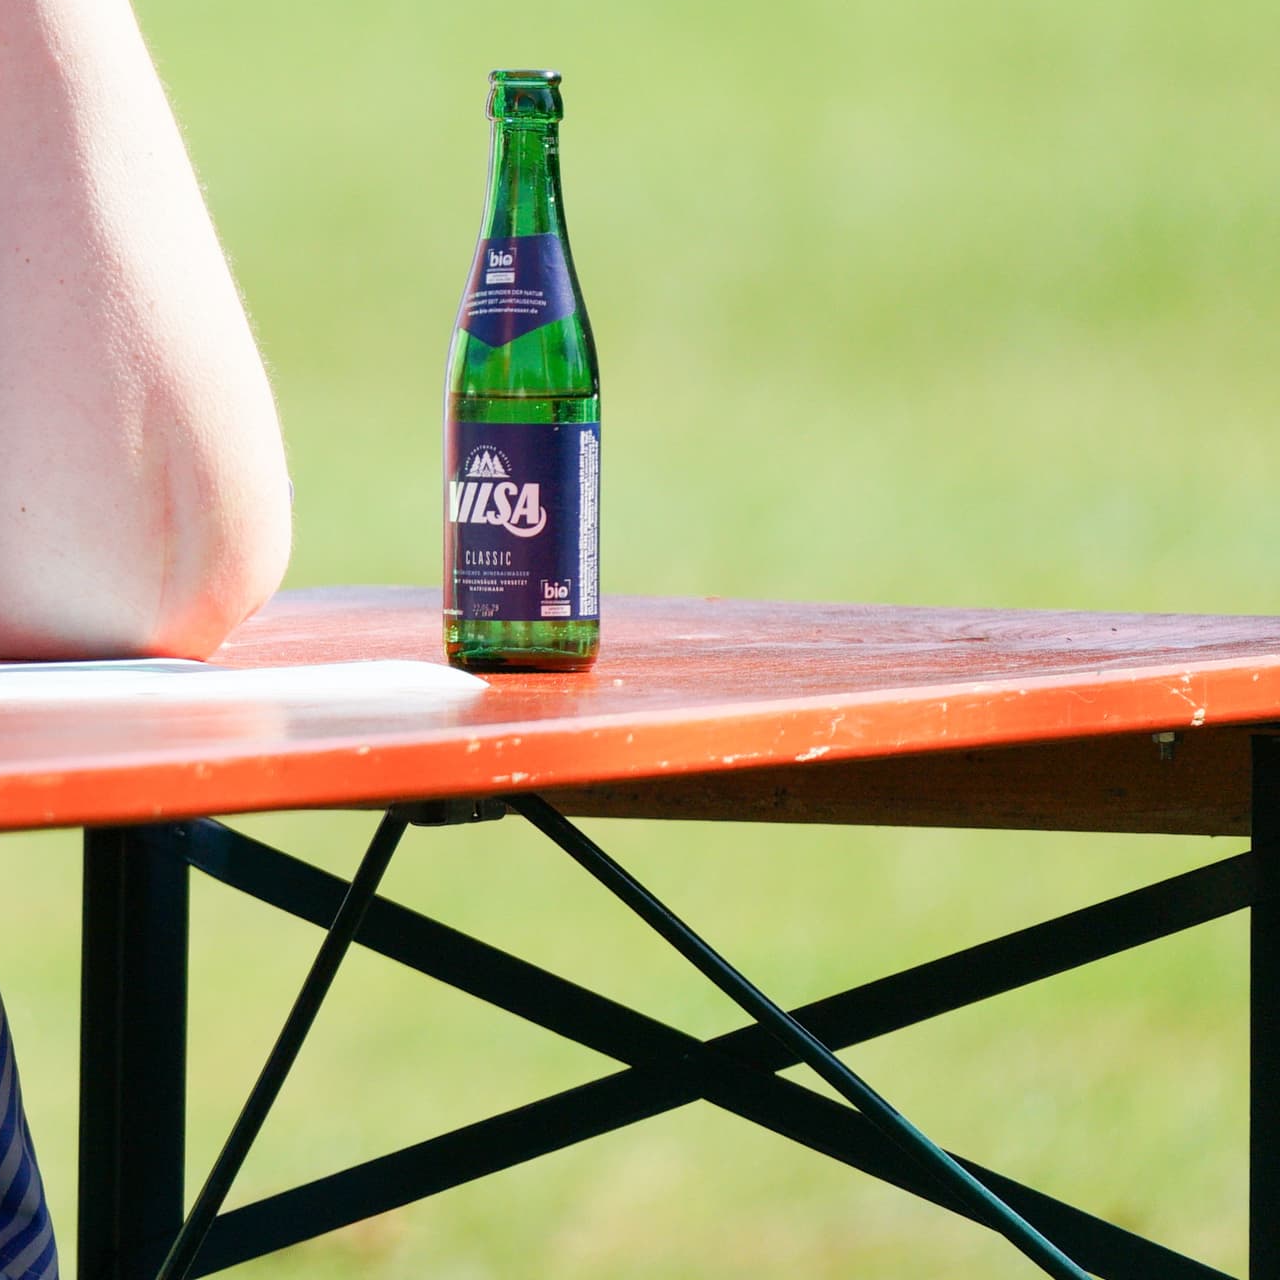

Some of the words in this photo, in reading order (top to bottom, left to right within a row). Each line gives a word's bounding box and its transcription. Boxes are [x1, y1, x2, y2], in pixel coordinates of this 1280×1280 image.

[489, 250, 513, 267] bio
[450, 481, 547, 537] VILSA
[466, 550, 512, 566] CLASSIC
[544, 582, 569, 599] bio
